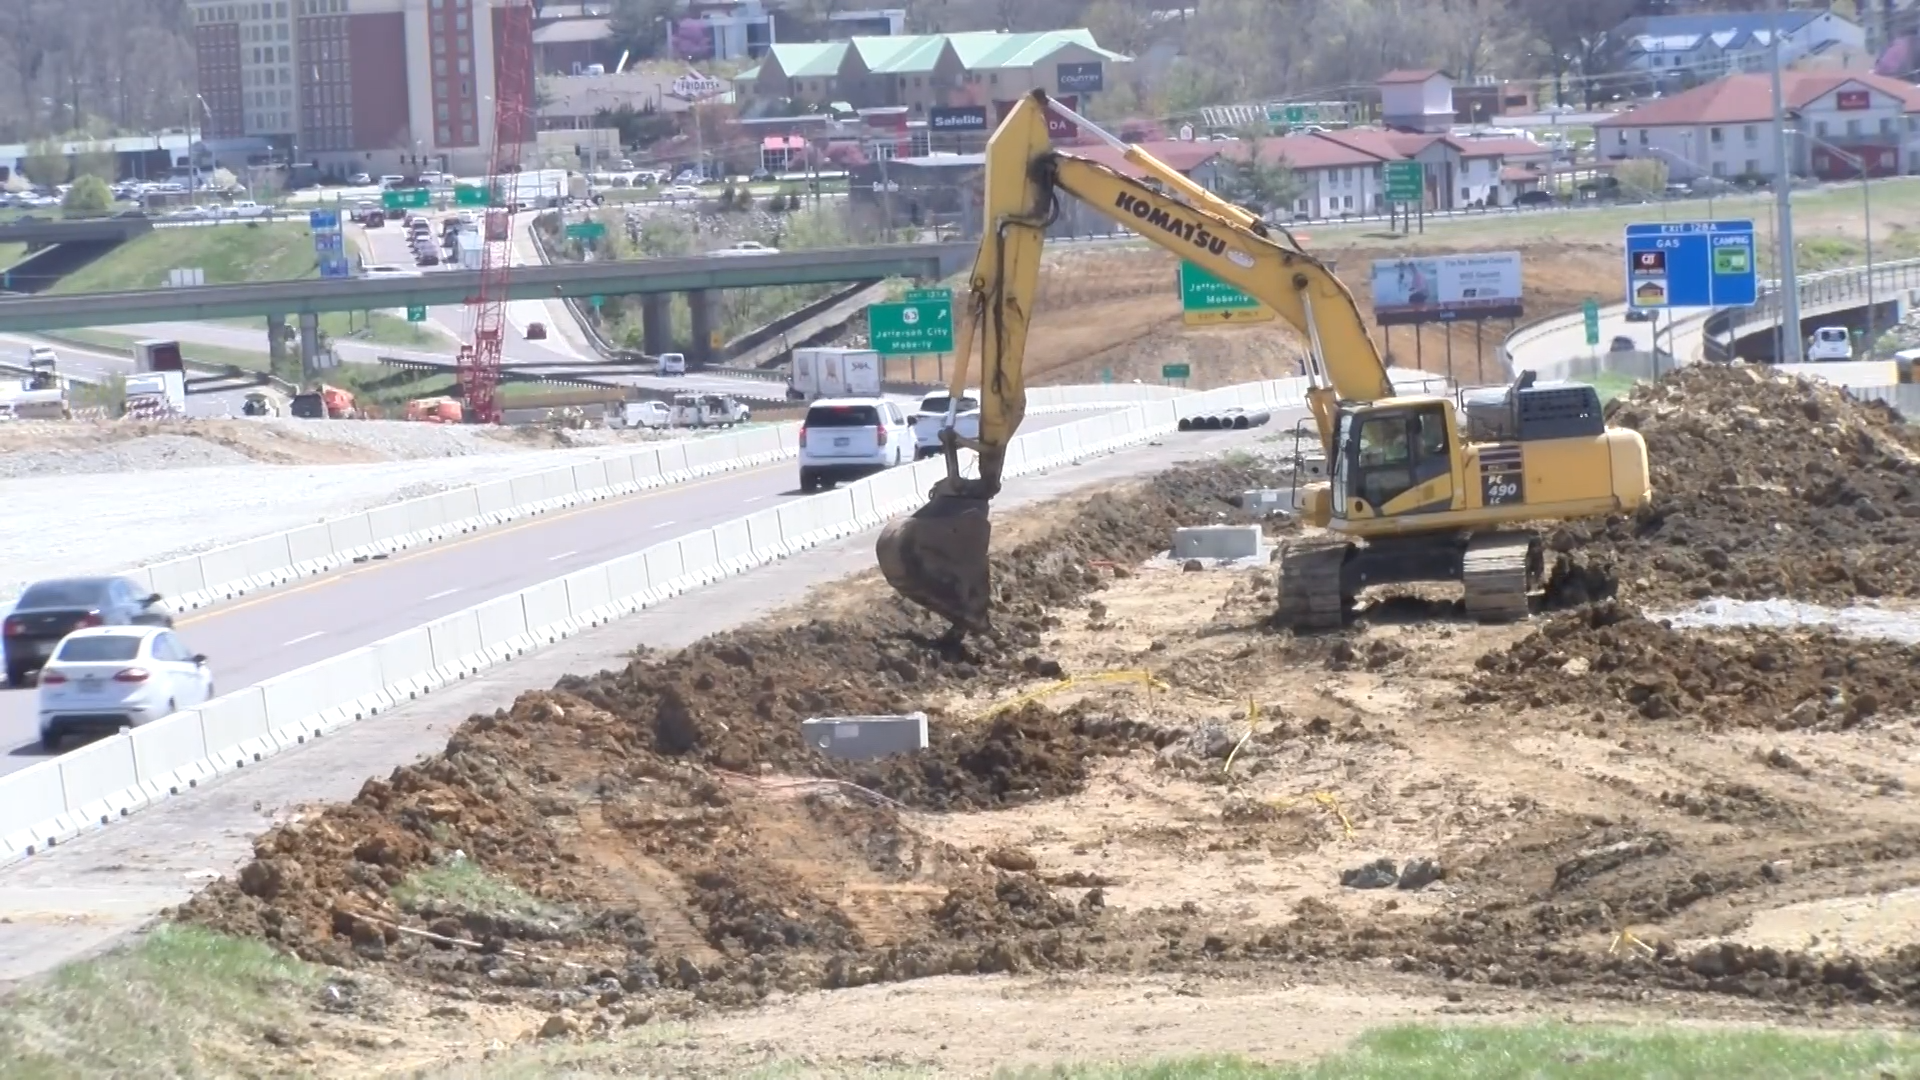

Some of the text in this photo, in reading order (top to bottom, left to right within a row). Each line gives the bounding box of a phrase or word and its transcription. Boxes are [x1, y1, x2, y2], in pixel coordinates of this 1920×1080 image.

[1661, 225, 1683, 233] EXIT
[1656, 239, 1680, 248] GAS
[1713, 236, 1749, 246] CAMPING
[1206, 295, 1249, 304] Moberly
[876, 327, 948, 339] Jefferson City
[1488, 475, 1503, 485] PC
[1488, 483, 1517, 496] 490
